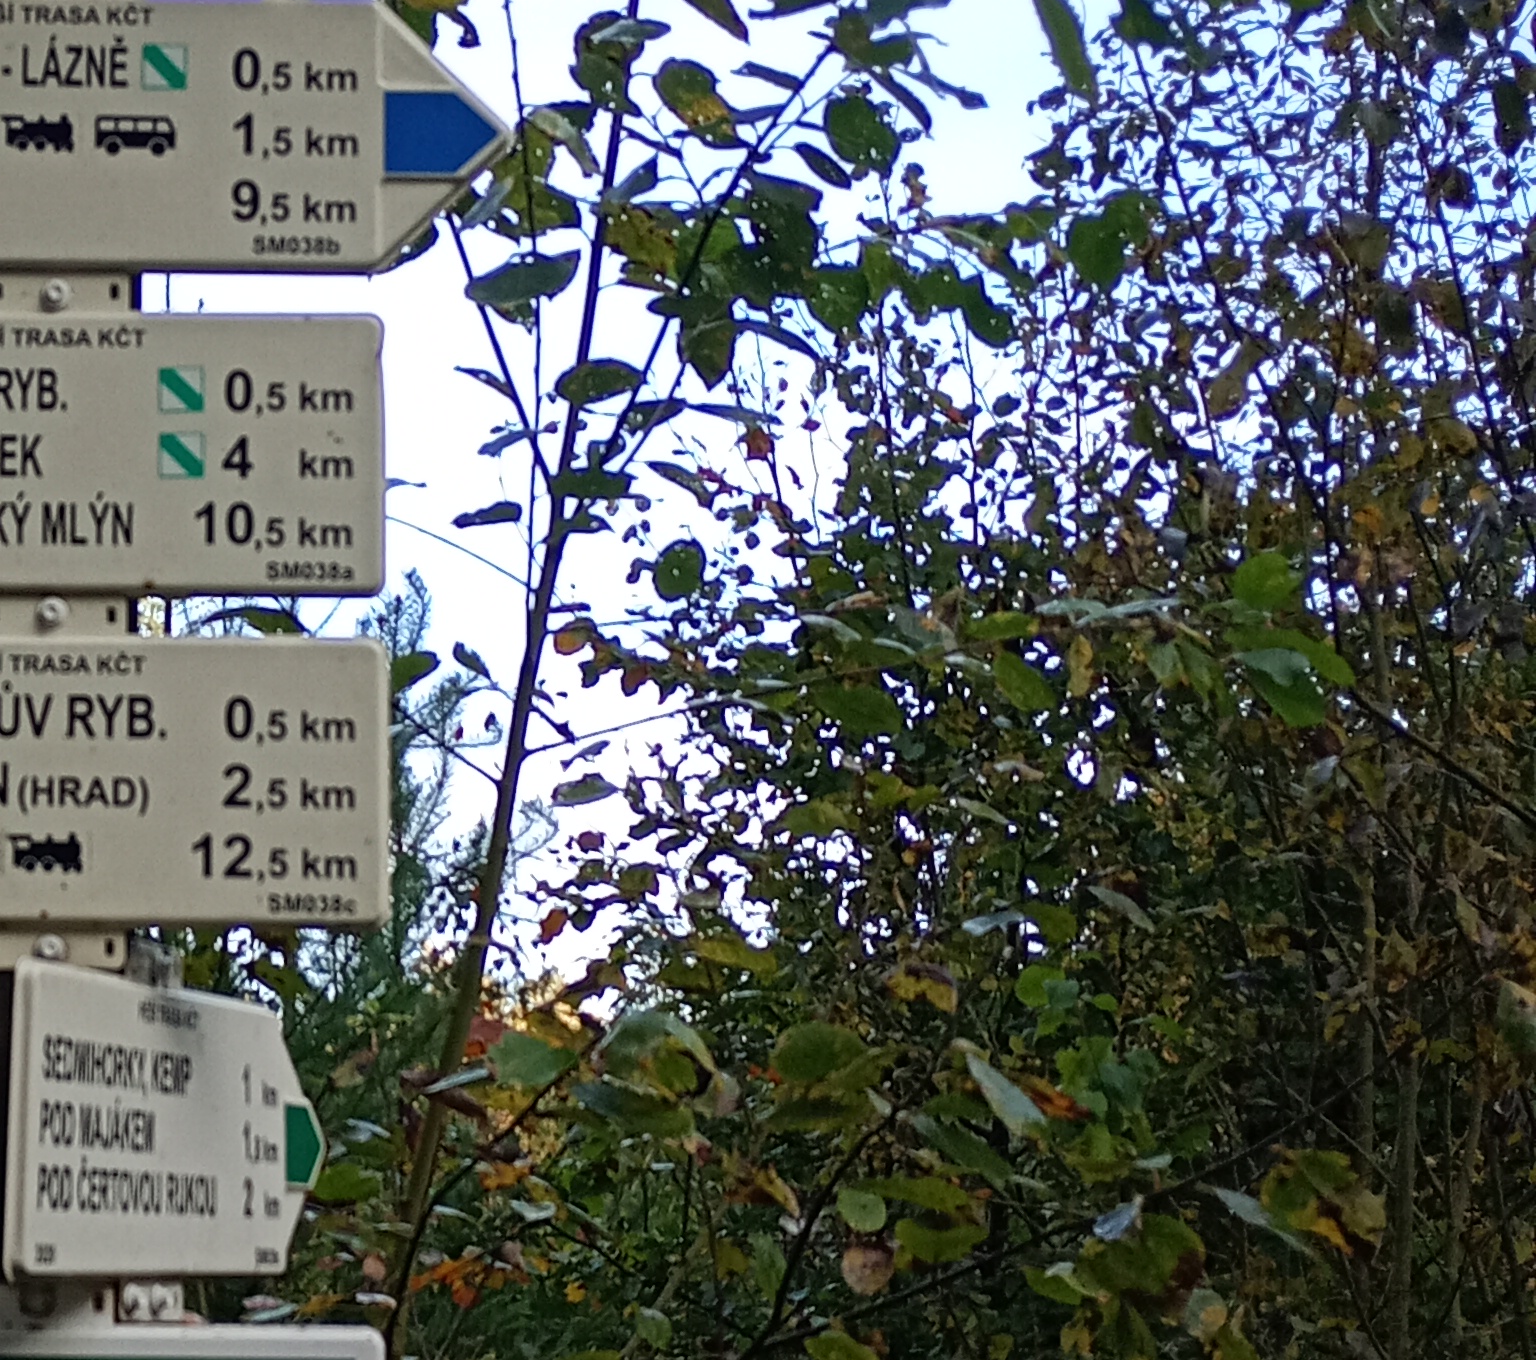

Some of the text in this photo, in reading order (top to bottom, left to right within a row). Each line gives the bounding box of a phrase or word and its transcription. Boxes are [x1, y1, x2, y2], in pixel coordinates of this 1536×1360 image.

[21, 4, 100, 26] TRASA
[106, 1, 155, 27] KČT
[21, 35, 129, 89] LÁZNĚ
[232, 47, 358, 95] 0,5 km
[233, 112, 359, 159] 1,5 km
[231, 180, 357, 225] 9,5 km
[11, 326, 91, 349] TRASA
[96, 324, 146, 349] KČT
[224, 369, 354, 415] 0,5 km
[221, 435, 354, 479] 4 km
[41, 493, 134, 546] MLÝN
[195, 501, 353, 550] 10,5 km
[11, 653, 92, 676] TRASA
[96, 651, 146, 676] KČT
[65, 694, 167, 740] RYB.
[224, 695, 356, 744] 0,5 km
[17, 776, 150, 815] (HRAD)
[222, 763, 356, 812] 2,5 km
[192, 833, 357, 881] 12,5 km
[150, 1050, 193, 1096] KEMP
[39, 1096, 156, 1154] POD MAJÁKEM
[37, 1154, 218, 1218] POD ČERTOVOU RUKOU
[242, 1176, 254, 1219] 2
